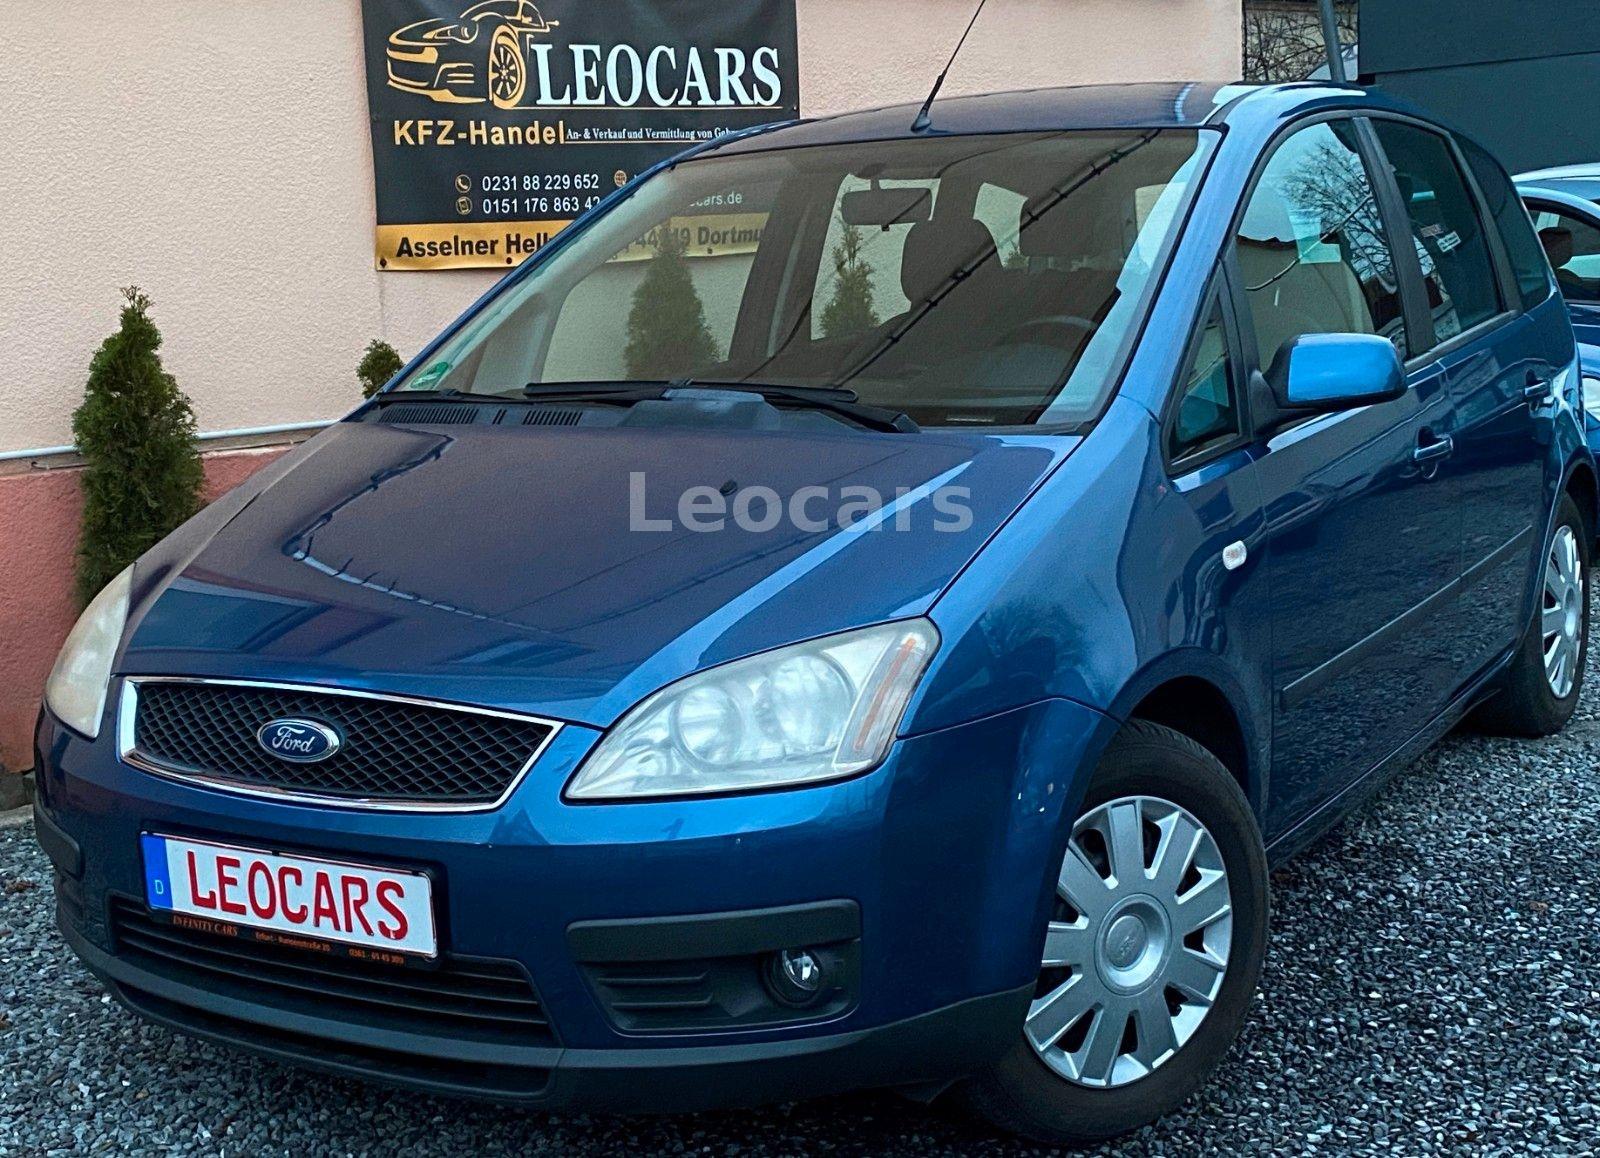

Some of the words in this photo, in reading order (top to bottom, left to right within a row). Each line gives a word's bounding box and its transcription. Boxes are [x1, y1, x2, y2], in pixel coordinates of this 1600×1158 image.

[531, 43, 782, 107] LEOCARS
[394, 120, 565, 146] KFZ-Handel
[566, 128, 581, 139] An-
[583, 128, 591, 139] &
[592, 127, 627, 140] Verkauf
[627, 127, 643, 139] und
[646, 127, 696, 141] Vermittlung
[697, 130, 712, 139] von
[482, 175, 517, 191] 0231
[523, 175, 540, 190] 88
[544, 174, 570, 190] 229
[574, 174, 599, 189] 652
[482, 198, 518, 214] 0151
[525, 197, 548, 212] 176
[553, 197, 579, 212] 863
[396, 235, 499, 258] Asselner
[506, 232, 553, 254] Hell
[271, 725, 316, 754] Ford
[155, 879, 164, 895] D
[186, 850, 409, 940] LEOCARS
[173, 914, 212, 932] INFINITY
[214, 923, 238, 937] CARS
